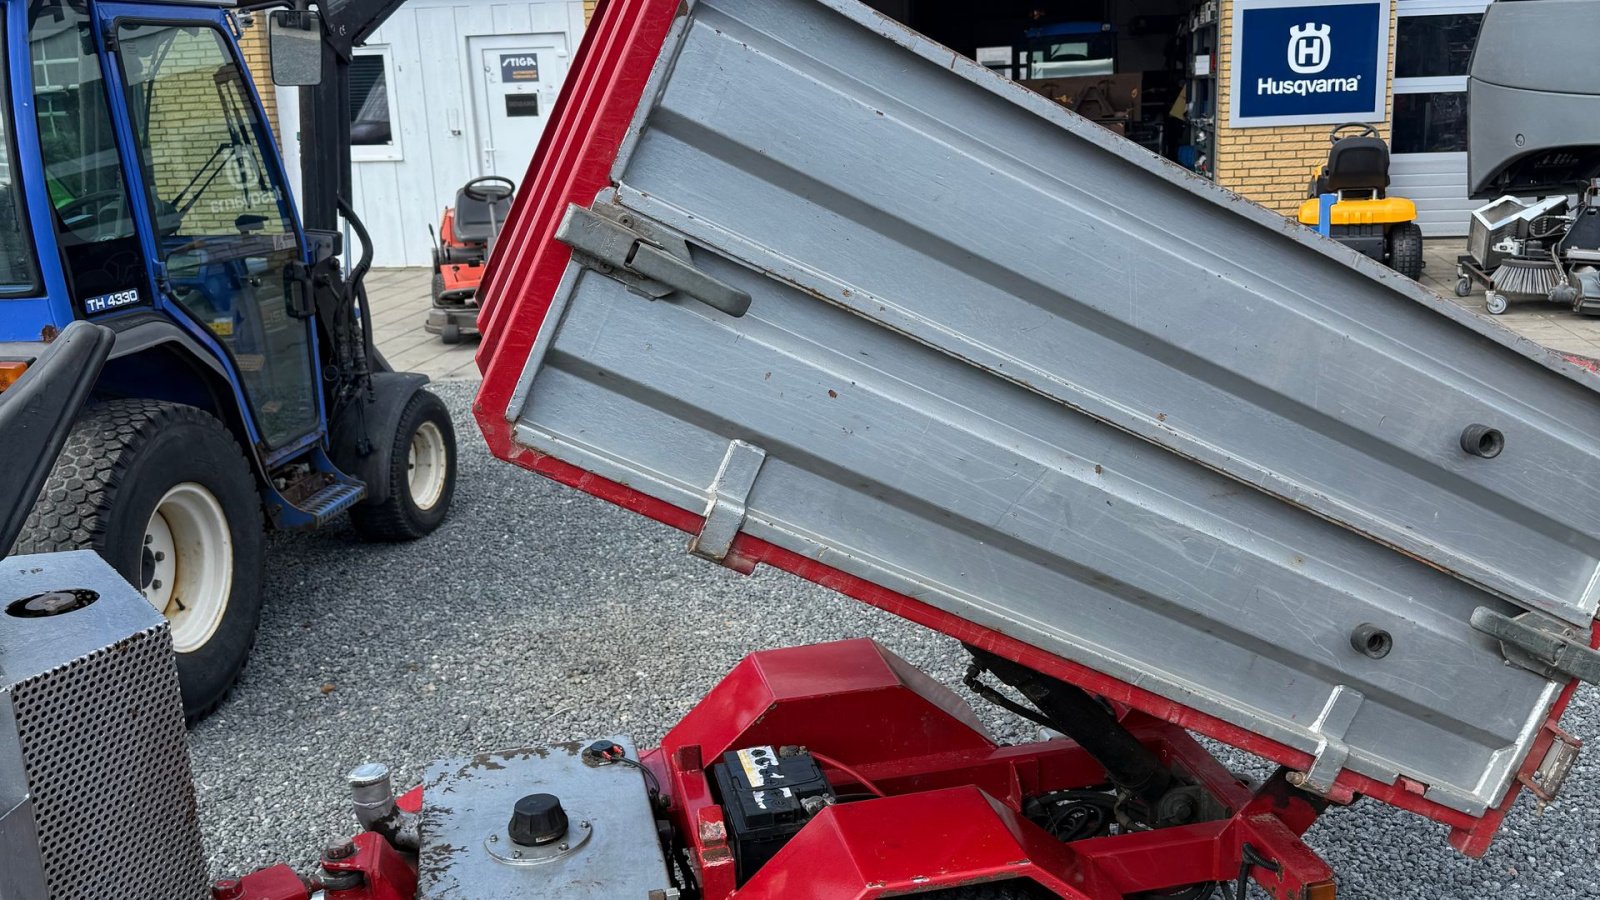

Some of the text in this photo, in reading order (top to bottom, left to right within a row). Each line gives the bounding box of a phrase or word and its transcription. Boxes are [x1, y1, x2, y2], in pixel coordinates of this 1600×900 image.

[502, 57, 537, 67] STIGA
[1257, 76, 1359, 97] Husqvarna
[87, 289, 138, 311] TH 4330
